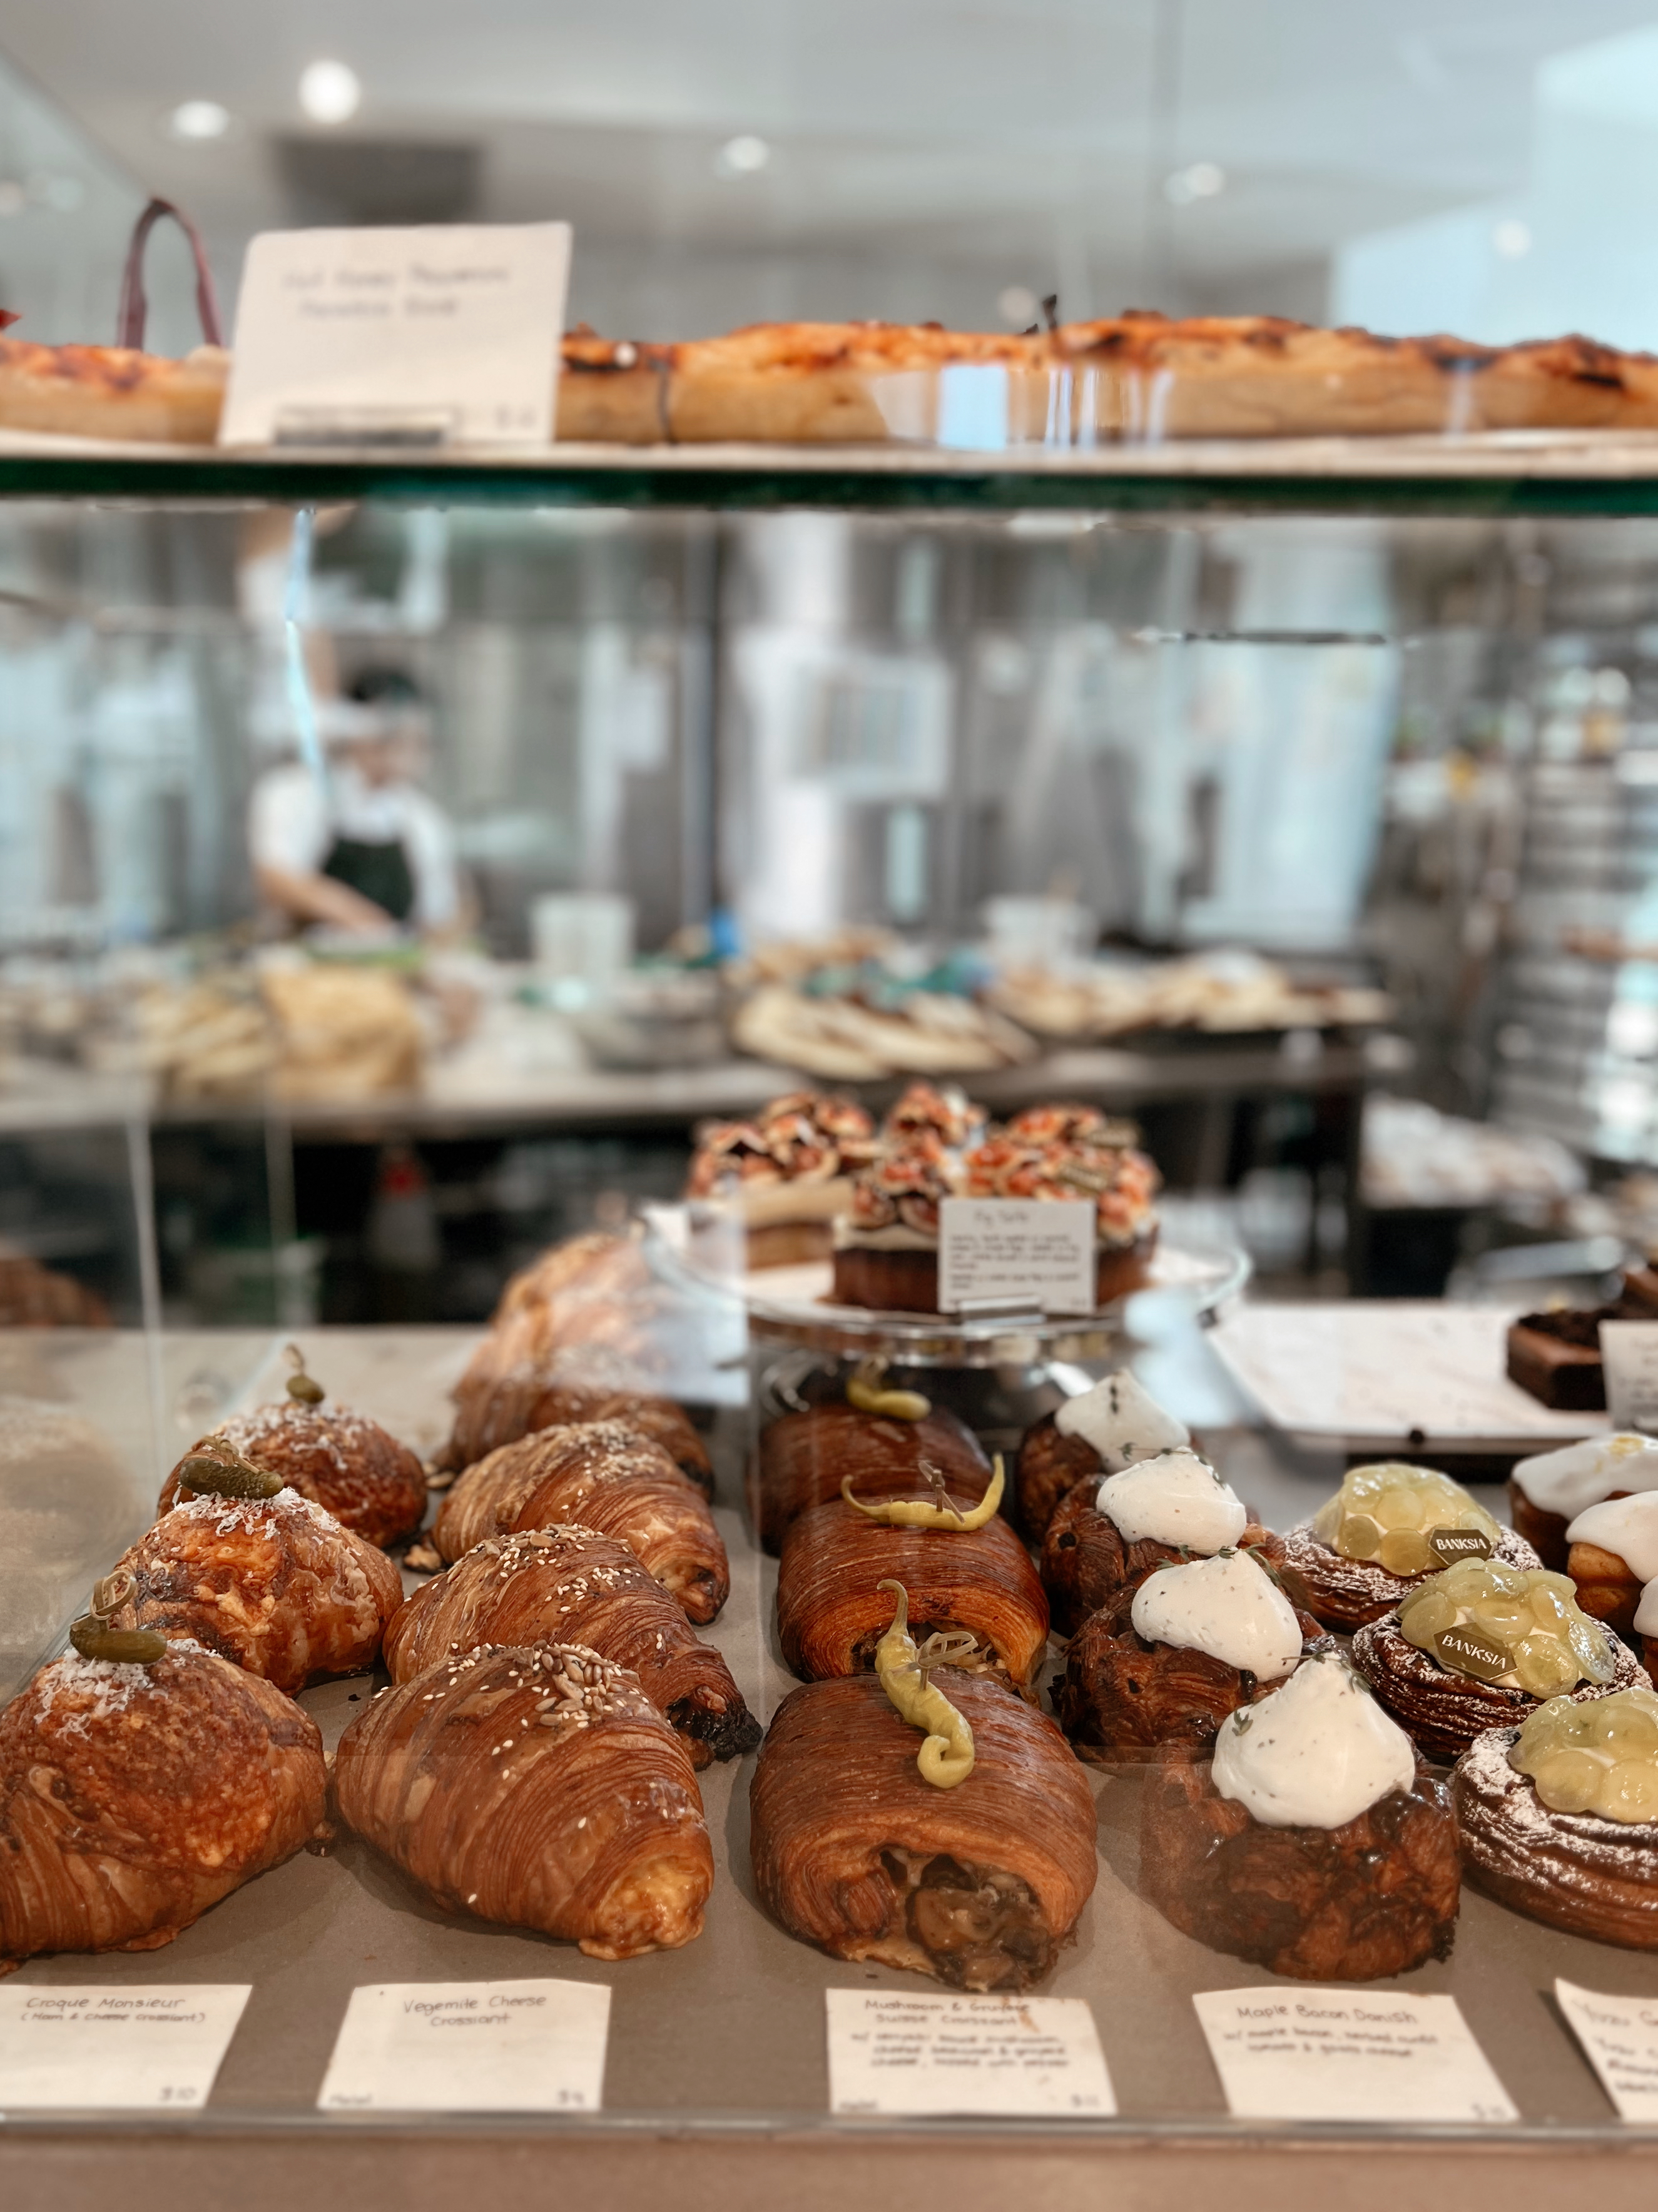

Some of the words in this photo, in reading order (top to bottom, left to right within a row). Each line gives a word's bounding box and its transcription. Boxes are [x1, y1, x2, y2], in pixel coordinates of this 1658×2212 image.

[1436, 1538, 1488, 1551] BANKSIA
[1441, 1634, 1507, 1670] BANKSIA
[26, 1997, 90, 2012] Croque
[98, 1997, 186, 2009] Monsieur
[404, 1998, 479, 2017] Vegemite
[489, 1995, 547, 2007] Cheese
[865, 2000, 944, 2011] Mushroom
[952, 2002, 962, 2011] &
[430, 2012, 512, 2027] Crossiant
[876, 2013, 928, 2024] Suisse
[1236, 2004, 1289, 2019] Maple
[1294, 2003, 1350, 2021] Bacon
[1353, 2008, 1418, 2024] Danish
